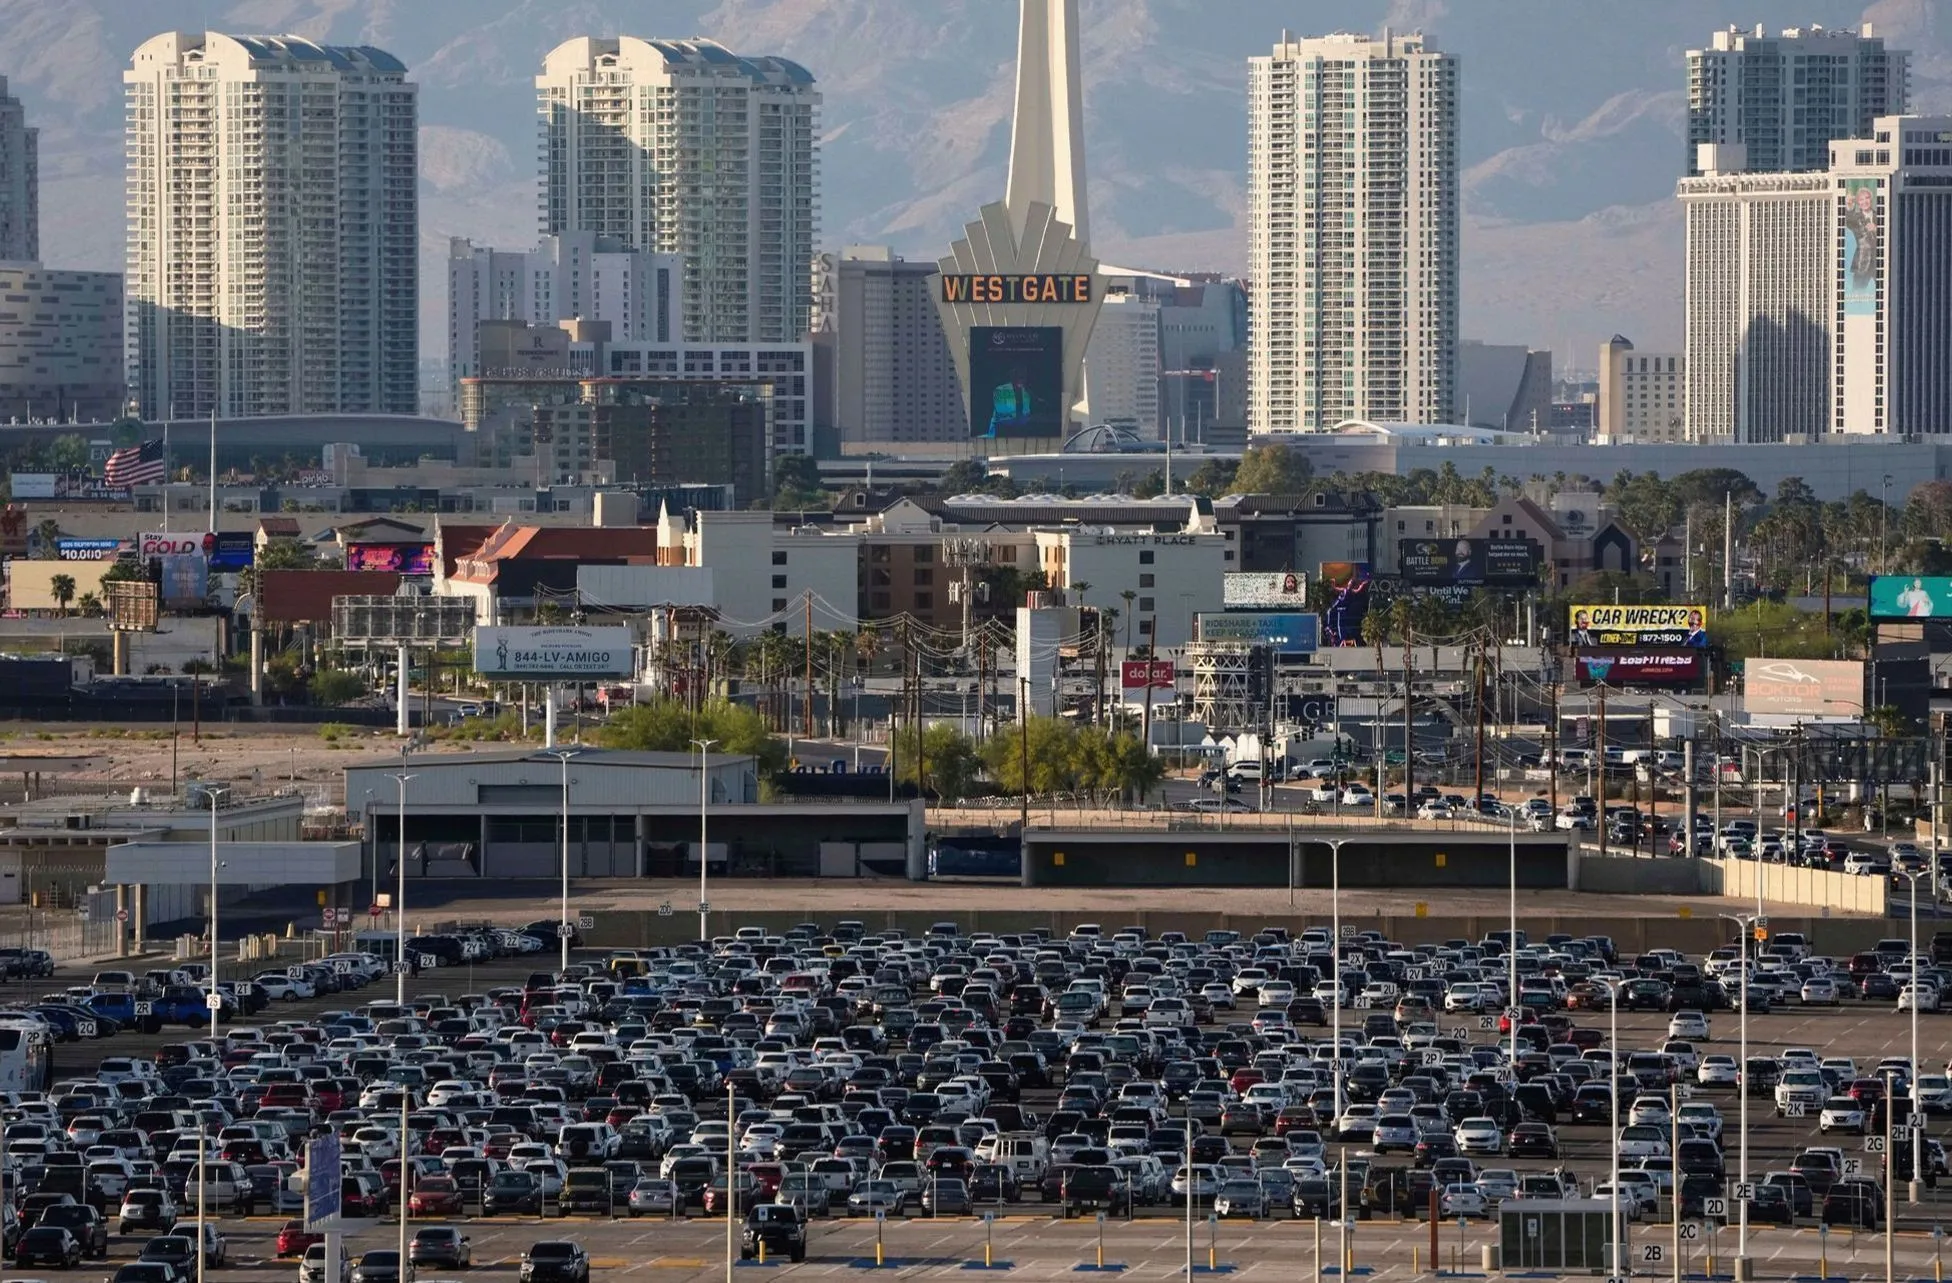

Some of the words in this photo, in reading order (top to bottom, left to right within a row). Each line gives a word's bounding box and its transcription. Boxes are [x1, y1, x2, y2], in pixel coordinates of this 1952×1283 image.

[944, 276, 1089, 301] WESTGATE
[144, 534, 163, 542] Stay
[1107, 536, 1147, 545] HYATT
[1155, 536, 1196, 545] PLACE
[143, 540, 196, 554] GOLD
[1406, 556, 1429, 566] BATTLE
[1429, 586, 1452, 595] Until
[1453, 585, 1469, 595] We
[1592, 609, 1622, 625] CAR
[1625, 609, 1687, 625] WRECK?
[1642, 633, 1682, 642] 877-1500
[514, 651, 610, 663] 844-LV-AMIGO
[1129, 667, 1167, 679] dolar.
[1747, 683, 1821, 697] BOKTOR
[580, 918, 592, 927] 2BB
[558, 927, 571, 936] 2AA
[506, 937, 517, 946] 2Z
[1295, 942, 1306, 951] 2Z
[466, 943, 477, 953] 2Y
[422, 956, 434, 966] 2X
[1350, 954, 1360, 964] 2X
[1432, 959, 1445, 970] 2W
[290, 967, 301, 978] 2U
[337, 963, 349, 973] 2V
[394, 962, 409, 972] 2W
[1409, 970, 1420, 979] 2V
[237, 983, 248, 994] 2T
[1383, 985, 1395, 994] 2U
[209, 996, 218, 1006] 2S
[1356, 997, 1368, 1007] 2T
[136, 1002, 149, 1013] 2R
[1507, 1007, 1520, 1018] 2S
[80, 1022, 94, 1034] 2Q
[1480, 1017, 1493, 1028] 2R
[27, 1032, 40, 1043] 2P
[1453, 1028, 1467, 1039] 2Q
[1425, 1053, 1437, 1064] 2P
[1331, 1060, 1345, 1070] 2N
[1497, 1070, 1511, 1082] 2M
[1787, 1103, 1803, 1116] 2K
[1909, 1114, 1924, 1127] 2J
[1891, 1126, 1906, 1140] 2H
[1867, 1138, 1883, 1151] 2G
[1845, 1160, 1859, 1173] 2F
[1736, 1184, 1751, 1198] 2E
[1708, 1200, 1724, 1214] 2D
[1680, 1224, 1696, 1239] 2C
[1644, 1246, 1662, 1260] 2B
